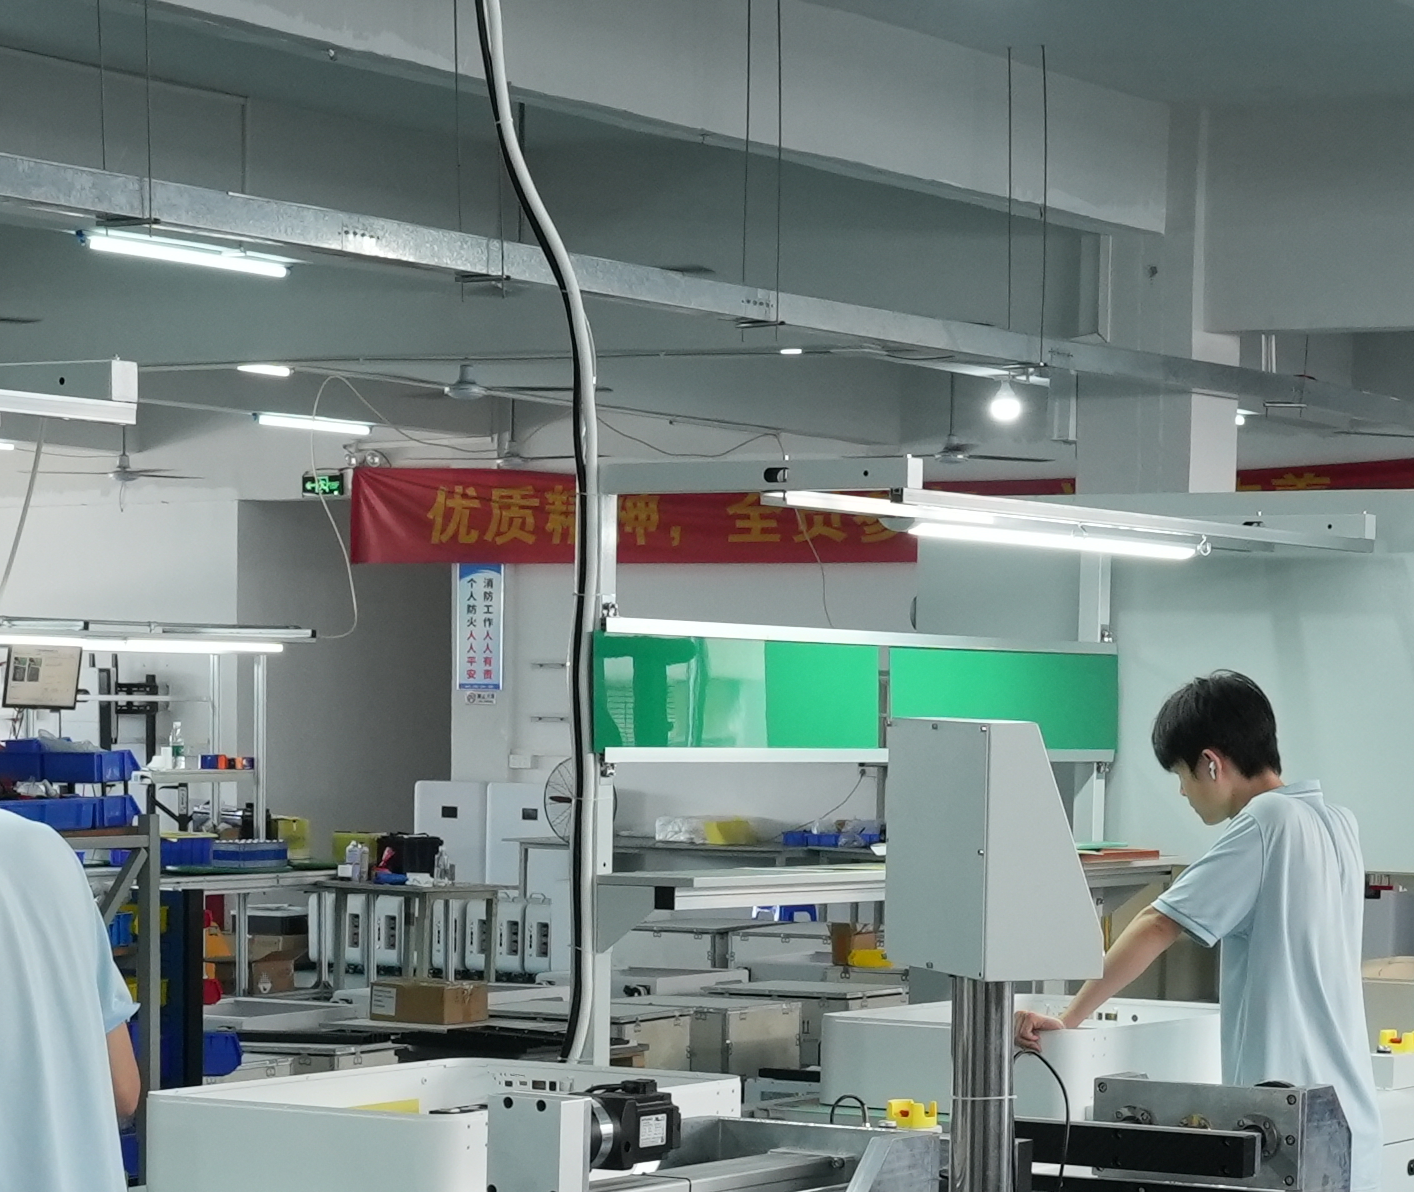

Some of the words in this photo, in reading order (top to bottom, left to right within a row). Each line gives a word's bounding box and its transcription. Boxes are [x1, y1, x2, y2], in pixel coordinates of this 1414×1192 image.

[466, 577, 477, 680] 个人防火人人平安
[483, 577, 494, 680] 消防工作人人有责
